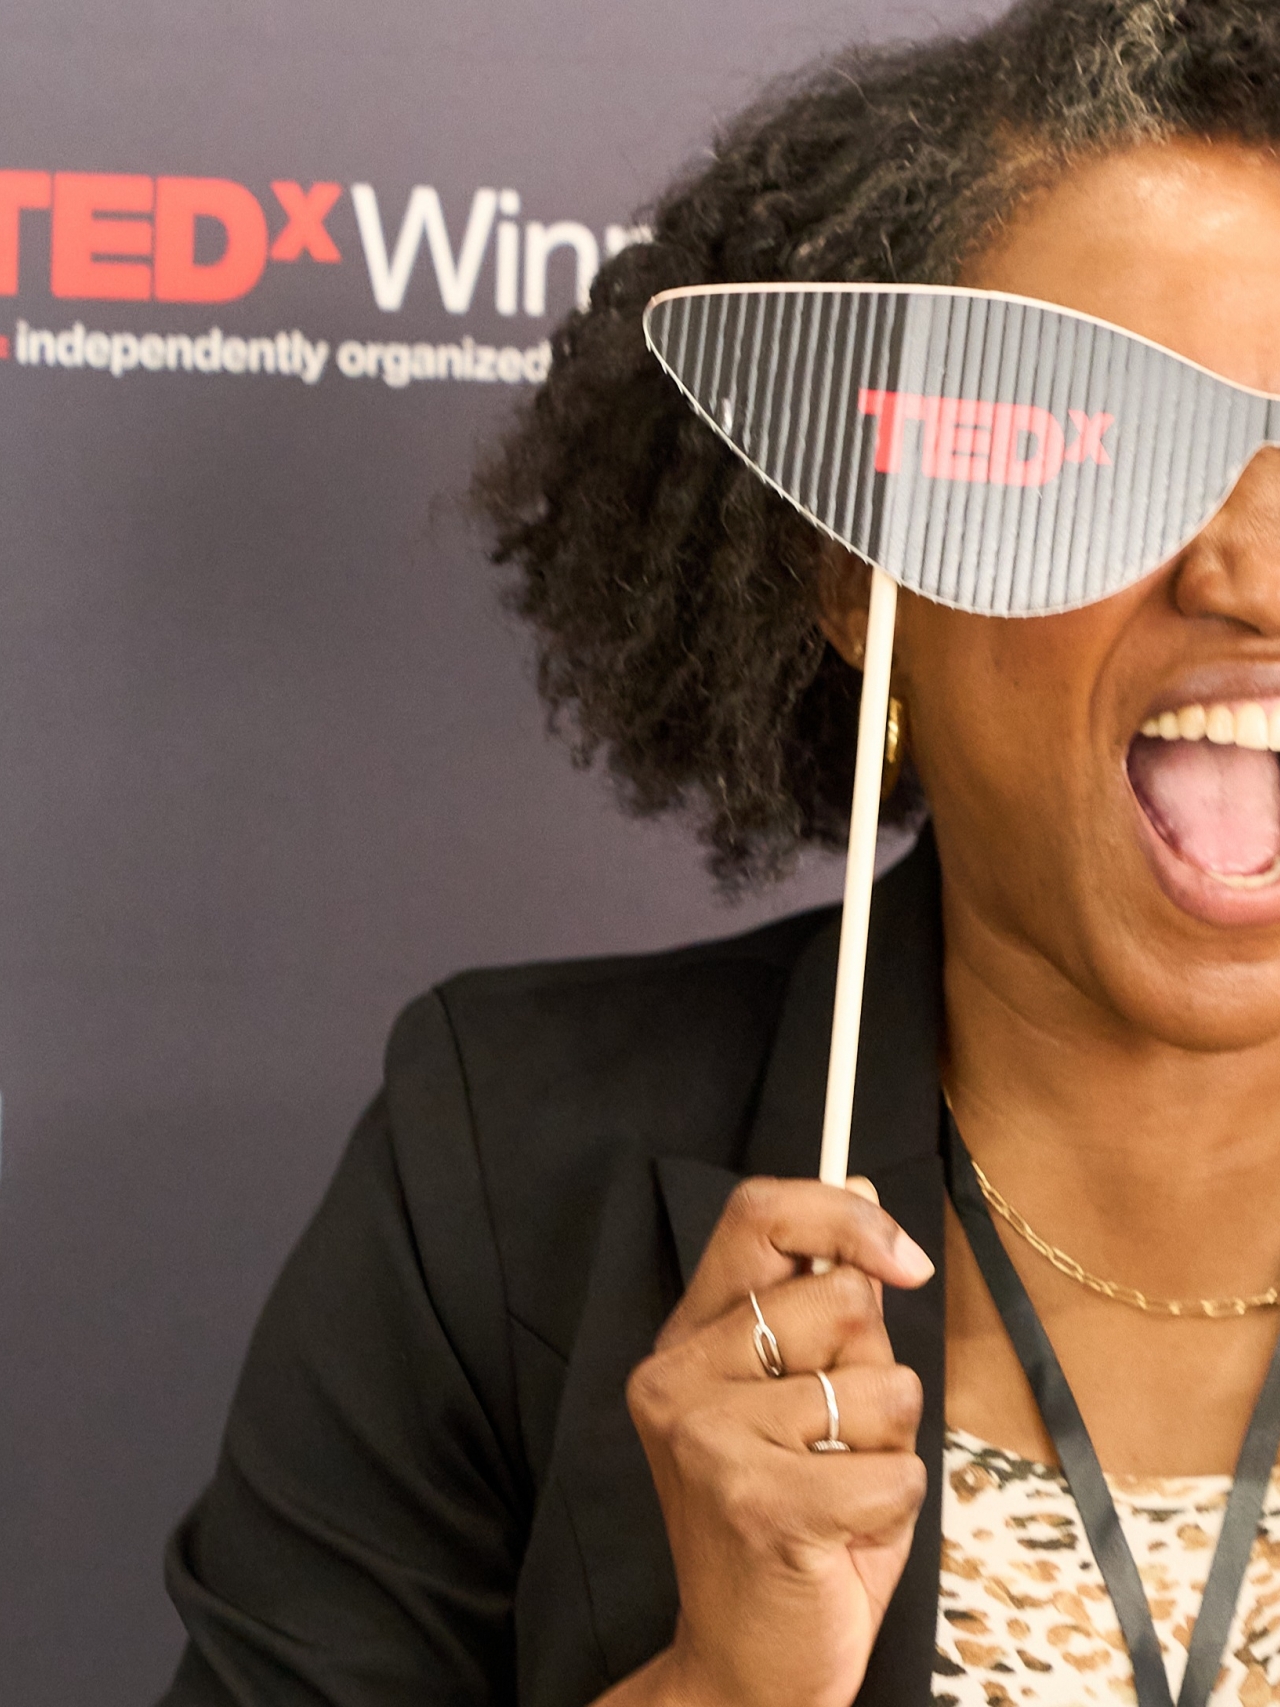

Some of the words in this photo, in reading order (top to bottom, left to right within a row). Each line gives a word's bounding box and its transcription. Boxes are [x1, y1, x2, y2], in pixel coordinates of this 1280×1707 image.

[0, 167, 655, 317] TEDxWin
[336, 335, 553, 388] organized
[857, 387, 1116, 488] TEDx
